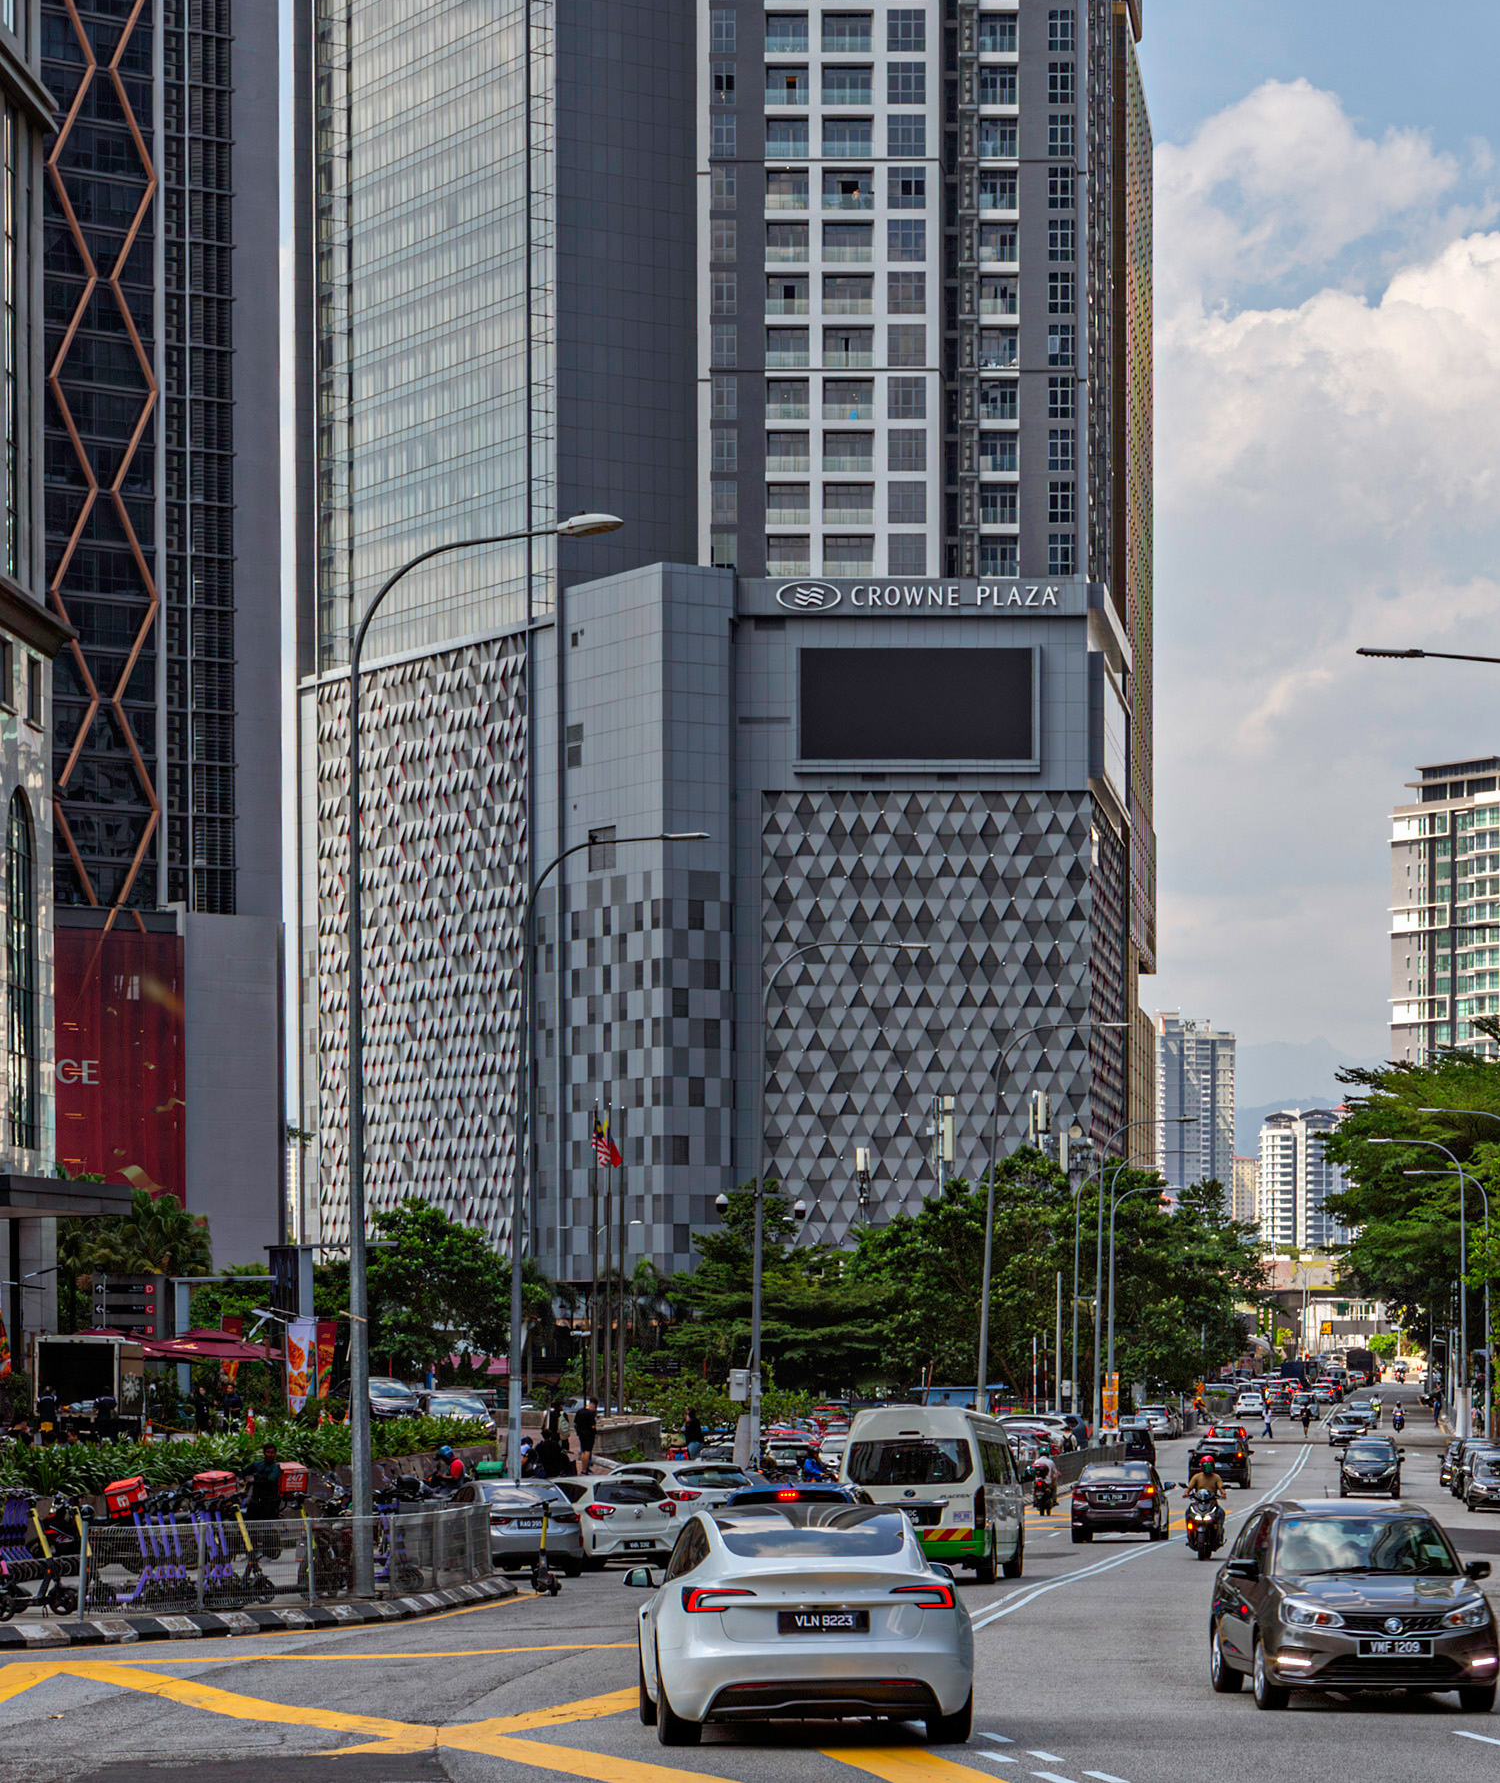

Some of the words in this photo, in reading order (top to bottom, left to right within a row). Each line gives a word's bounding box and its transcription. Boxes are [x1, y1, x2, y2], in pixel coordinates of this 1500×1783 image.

[850, 585, 960, 607] CROWNE
[976, 585, 1058, 607] PLAZA
[146, 1285, 154, 1293] D
[146, 1305, 153, 1313] C
[795, 1615, 820, 1627] VLN
[821, 1615, 853, 1626] 8223
[1394, 1641, 1421, 1653] 1209
